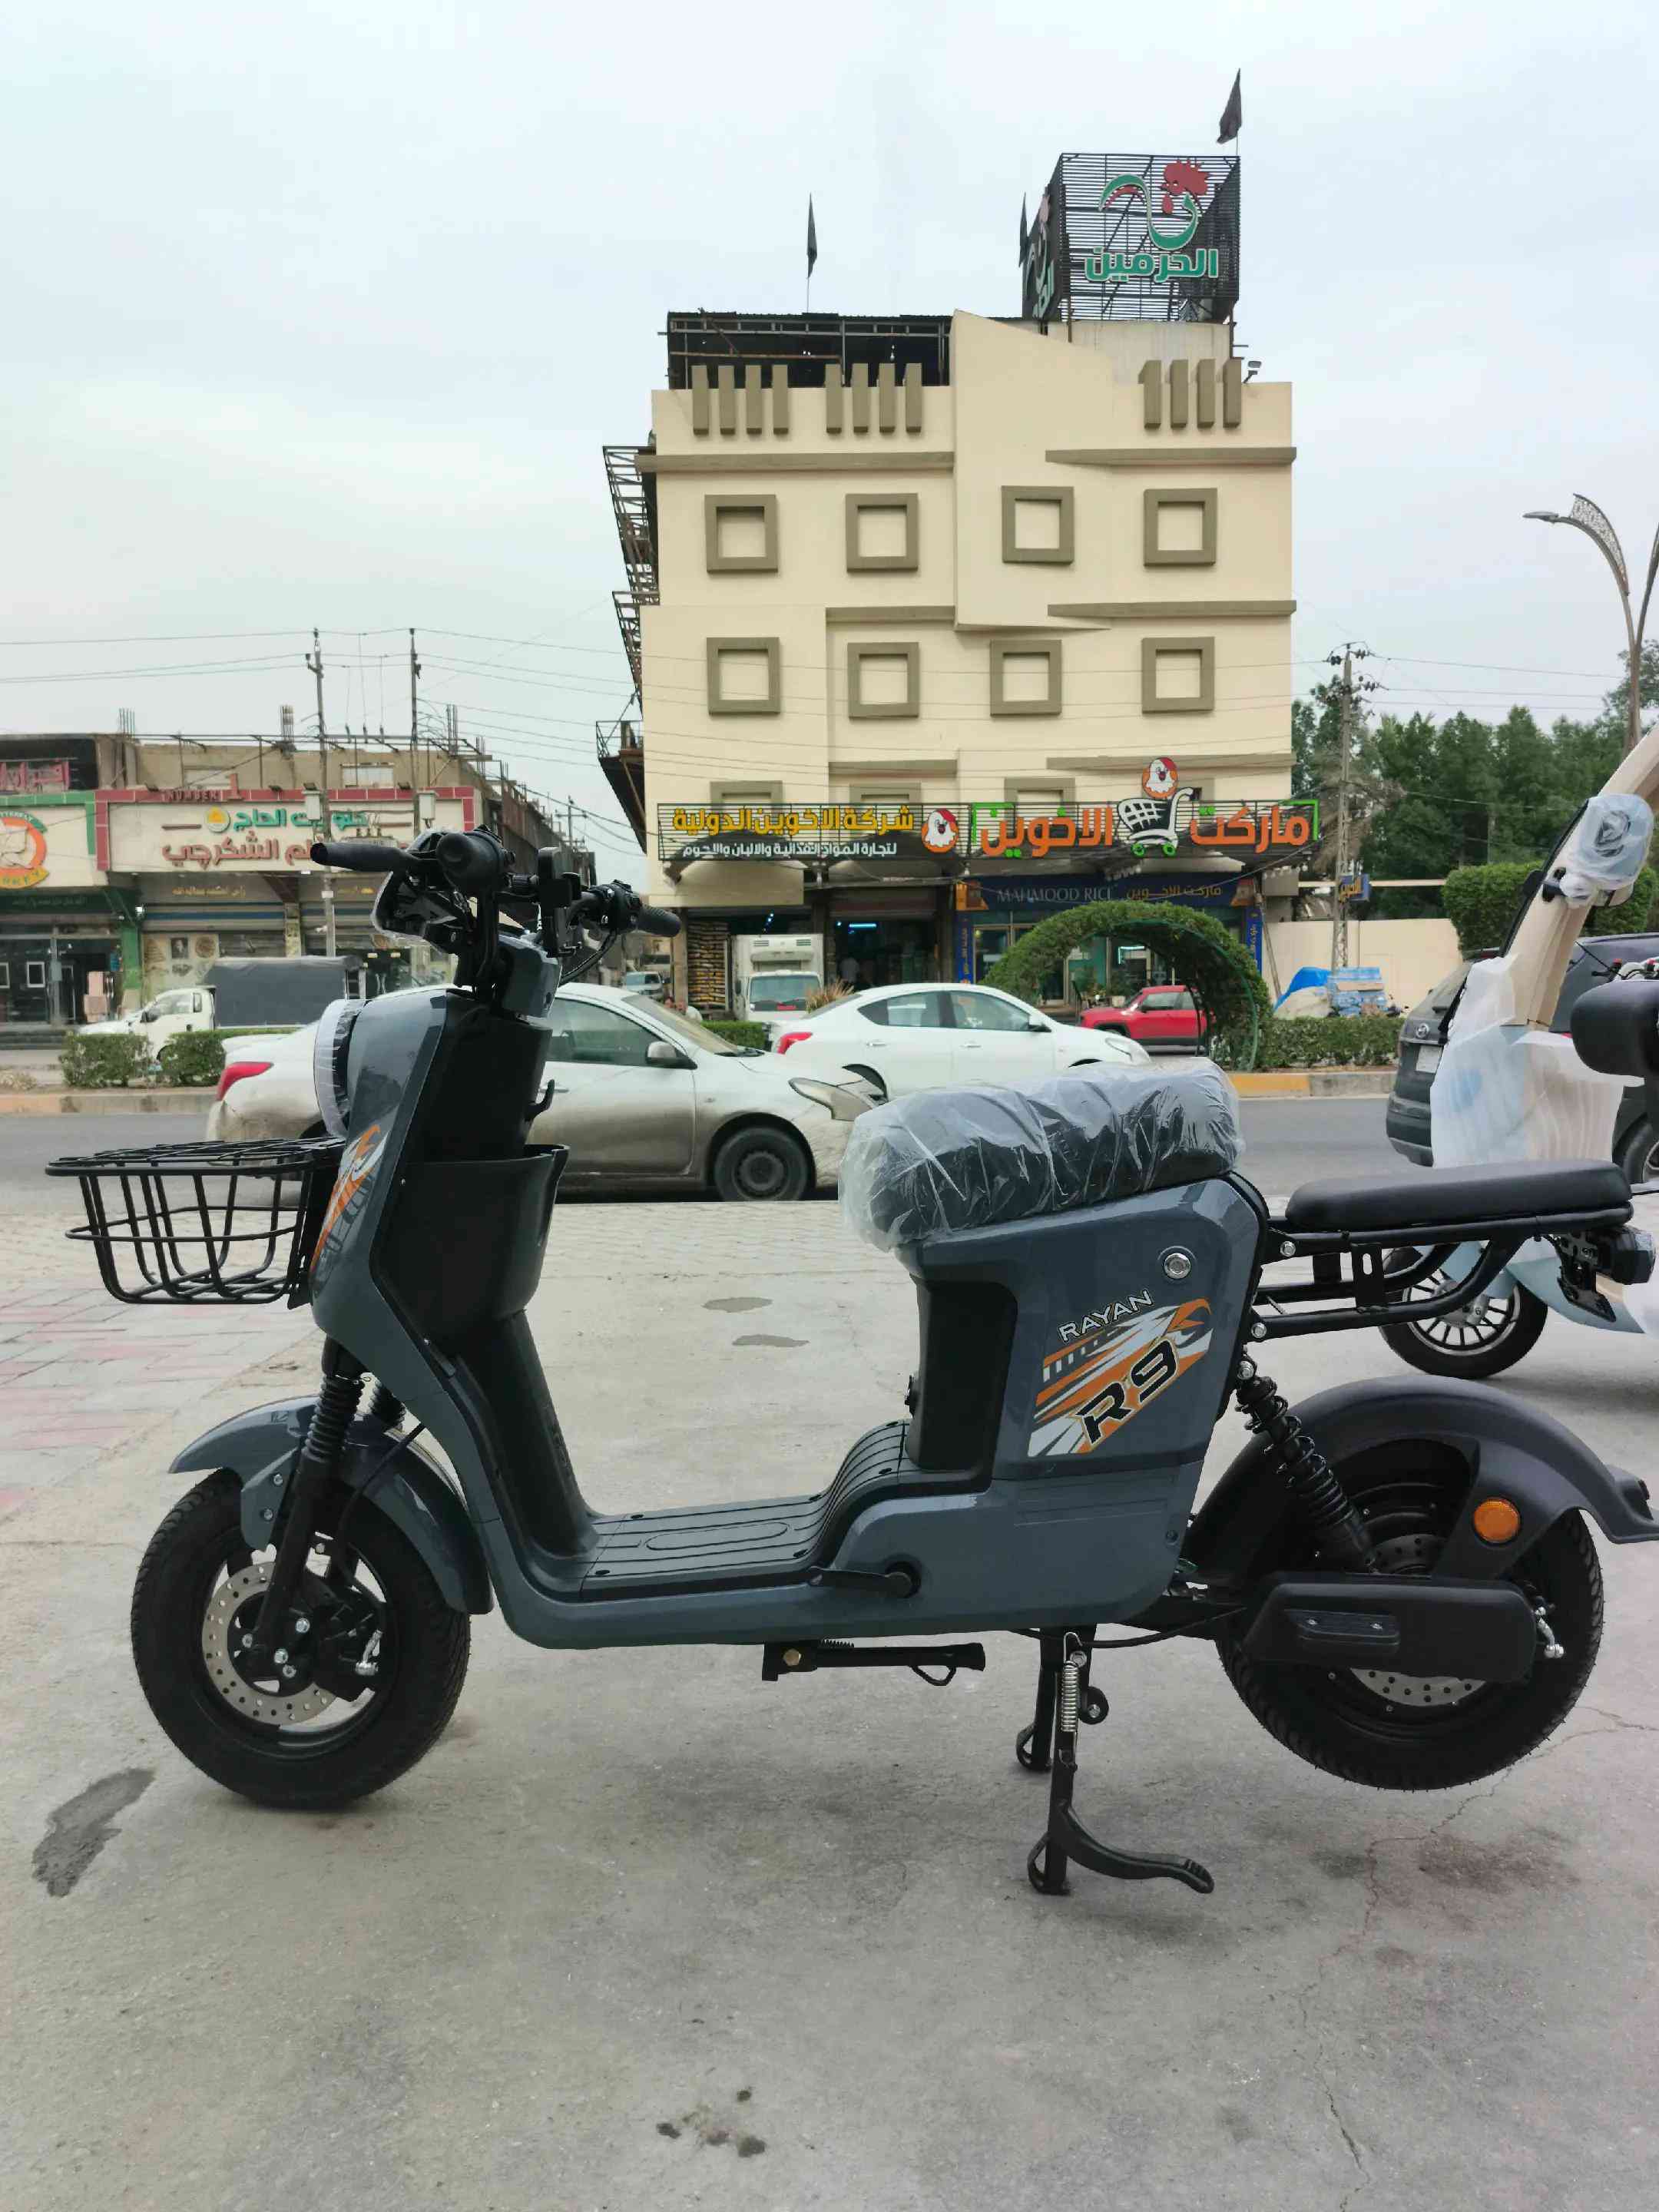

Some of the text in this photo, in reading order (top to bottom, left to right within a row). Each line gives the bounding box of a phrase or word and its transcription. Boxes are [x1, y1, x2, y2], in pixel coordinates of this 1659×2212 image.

[1084, 246, 1219, 283] الحرمين
[233, 808, 287, 832] الحاج
[672, 807, 753, 836] الدولية
[843, 804, 915, 836] شركة
[980, 804, 1310, 858] ماركت الاخوين
[998, 887, 1080, 902] MAHMOOD
[1057, 1289, 1154, 1343] RAYAN
[1075, 1338, 1180, 1446] R9
